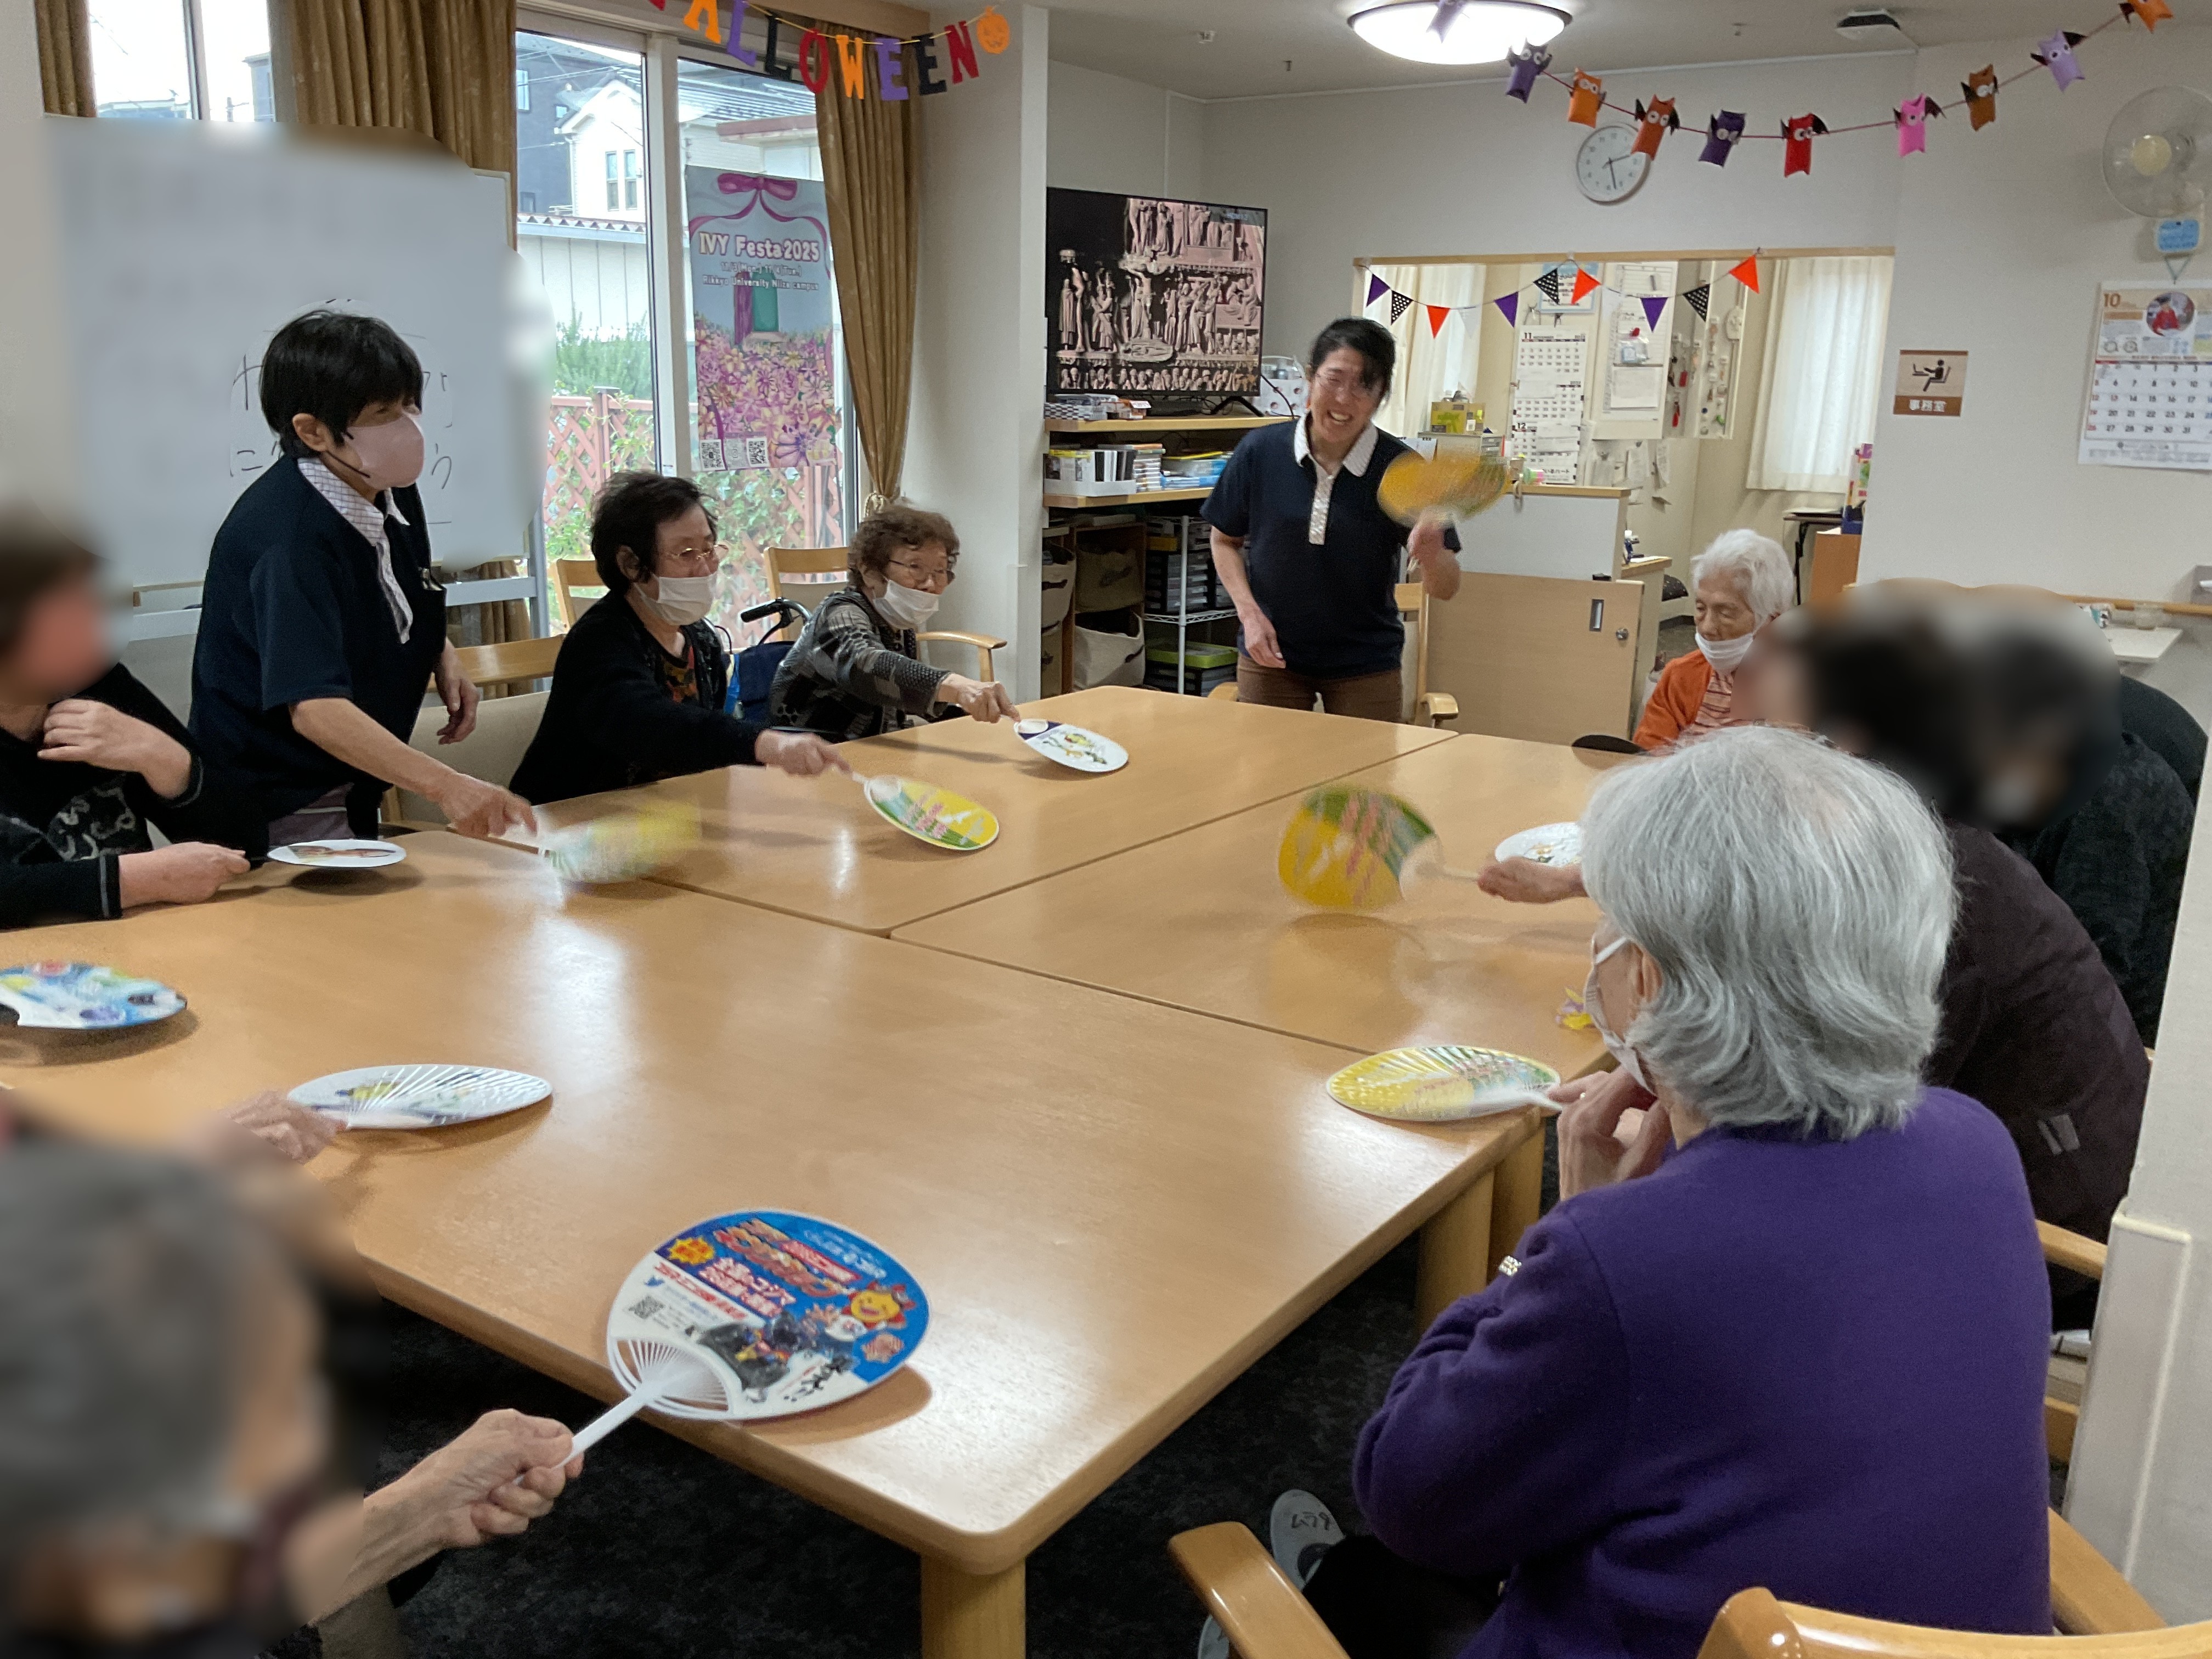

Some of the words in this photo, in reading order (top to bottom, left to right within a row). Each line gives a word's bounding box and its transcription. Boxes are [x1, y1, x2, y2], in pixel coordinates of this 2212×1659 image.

[649, 0, 979, 101] ALLOWEEN
[699, 232, 730, 256] IVY
[2103, 292, 2121, 307] 10
